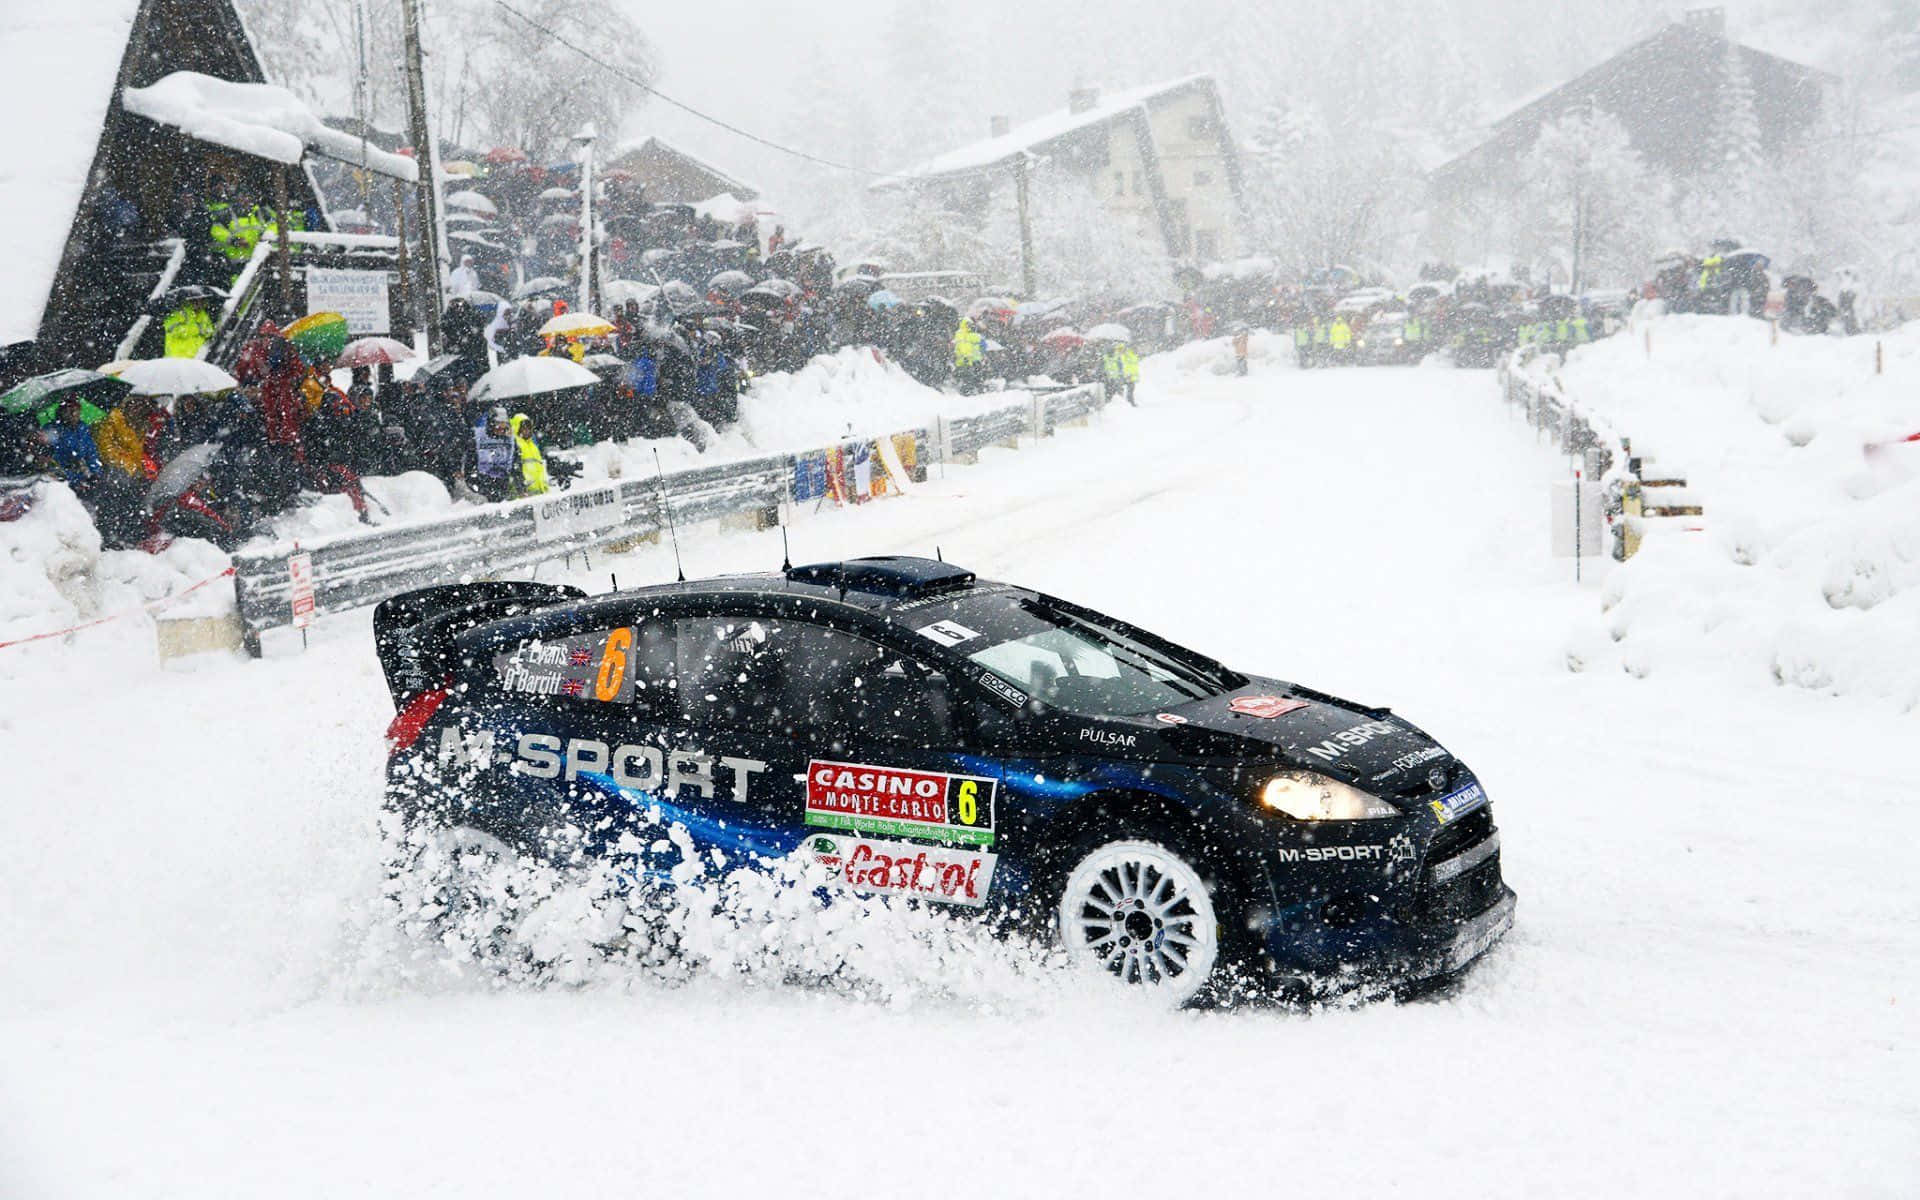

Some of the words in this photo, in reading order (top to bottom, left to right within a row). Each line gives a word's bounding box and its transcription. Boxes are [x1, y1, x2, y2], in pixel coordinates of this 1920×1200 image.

[528, 638, 568, 666] Evans
[595, 627, 632, 701] 6
[516, 668, 562, 695] Barritt
[1079, 728, 1137, 747] PULSAR
[1306, 721, 1405, 761] M-SPO
[438, 727, 766, 803] M-SPORT
[815, 769, 939, 798] CASINO
[825, 791, 942, 819] MONTE-CARLO
[958, 780, 978, 825] 6
[1367, 807, 1396, 816] PIAA
[1278, 845, 1384, 862] M-SPORT
[845, 845, 981, 899] Castrol
